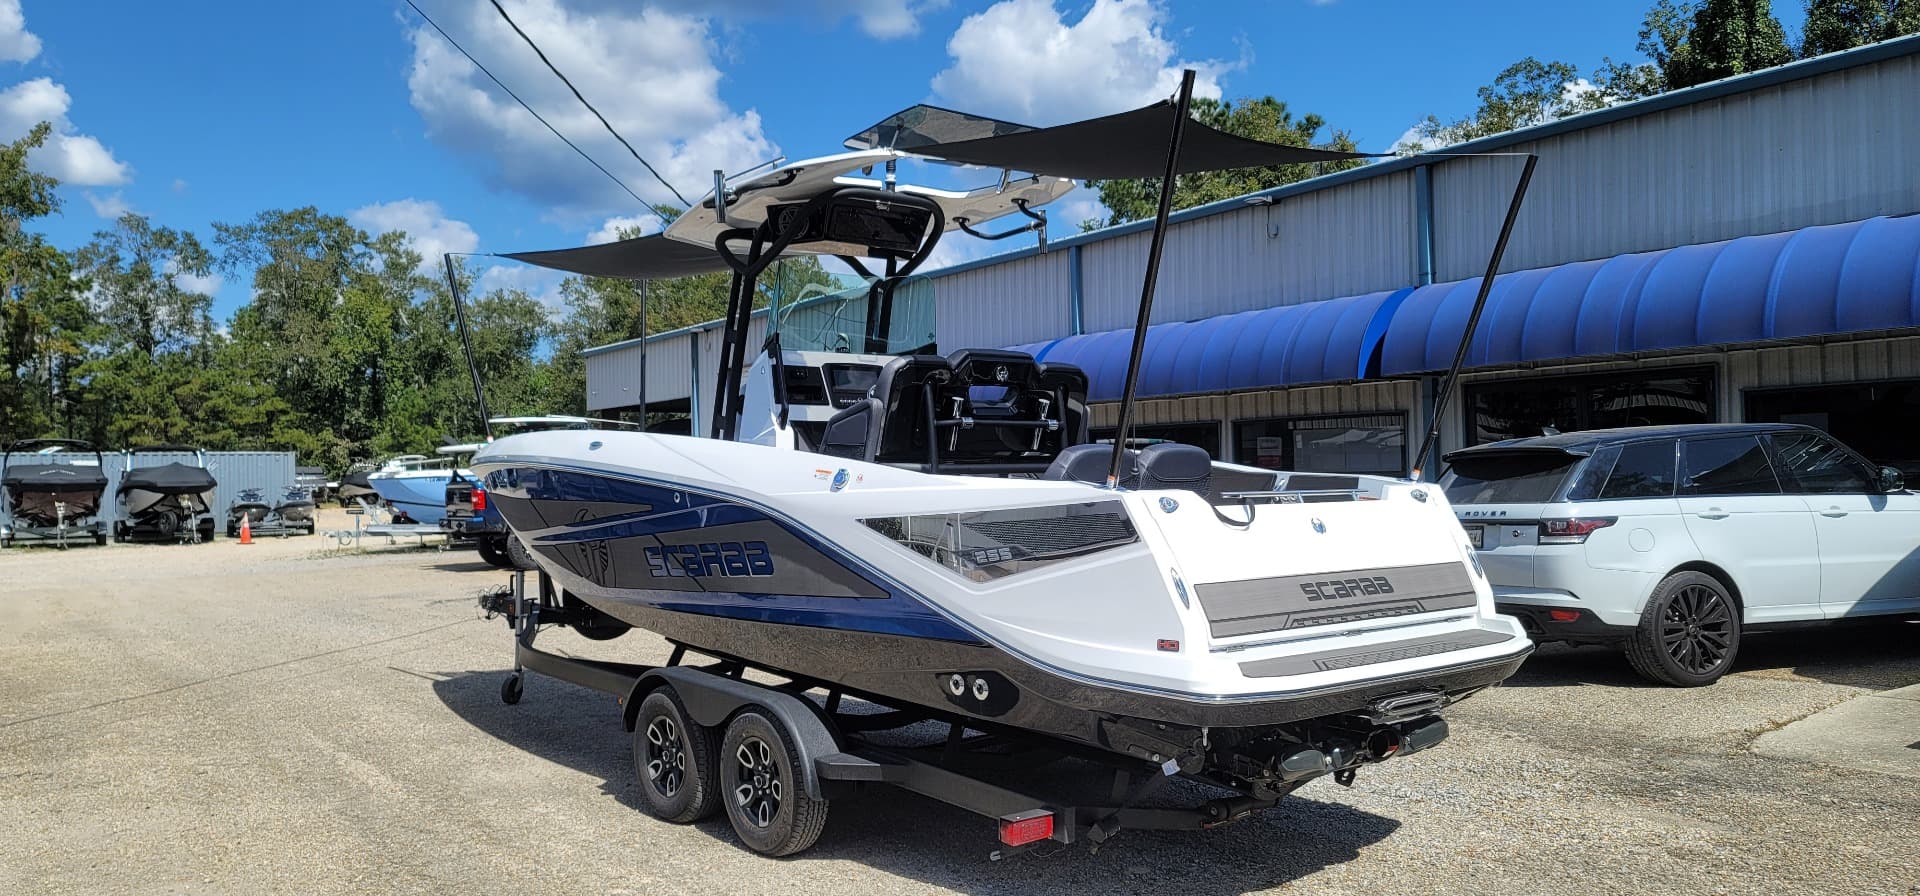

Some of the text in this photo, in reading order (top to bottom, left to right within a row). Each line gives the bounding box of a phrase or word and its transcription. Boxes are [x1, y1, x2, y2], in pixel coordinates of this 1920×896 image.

[643, 541, 775, 577] SCARAB
[974, 547, 1013, 564] 255
[1300, 576, 1395, 602] SCARAB
